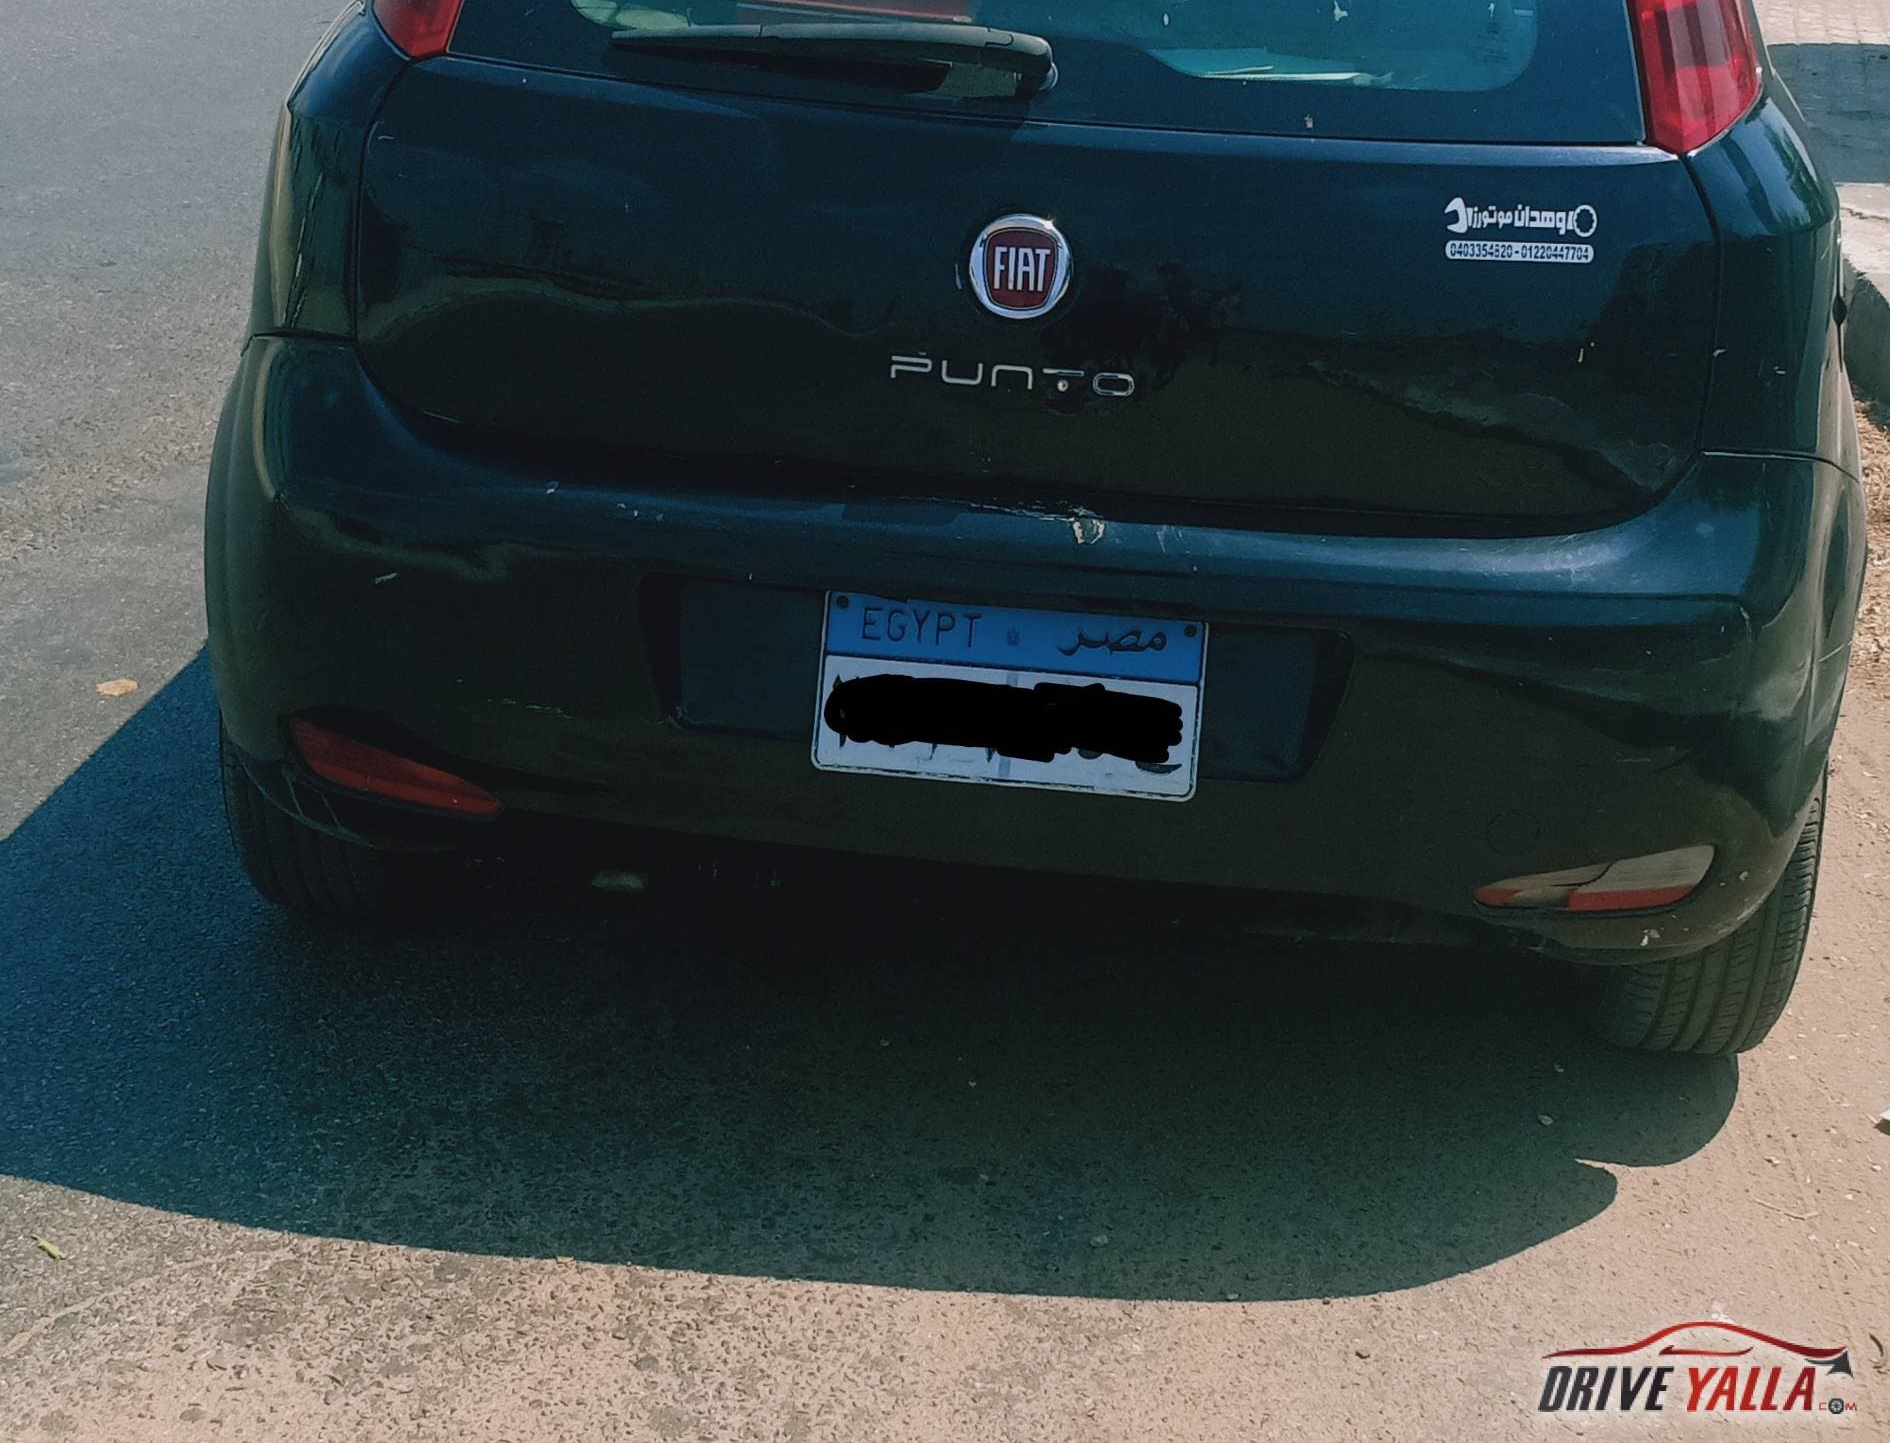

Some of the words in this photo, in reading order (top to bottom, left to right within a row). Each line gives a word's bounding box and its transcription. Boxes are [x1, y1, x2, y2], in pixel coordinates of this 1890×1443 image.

[1472, 206, 1513, 229] موتورز
[1514, 204, 1567, 235] وهدان
[993, 246, 1051, 292] FIAT
[890, 354, 1135, 397] PUNTO
[861, 606, 982, 648] EGYPT
[1057, 630, 1167, 656] مصر
